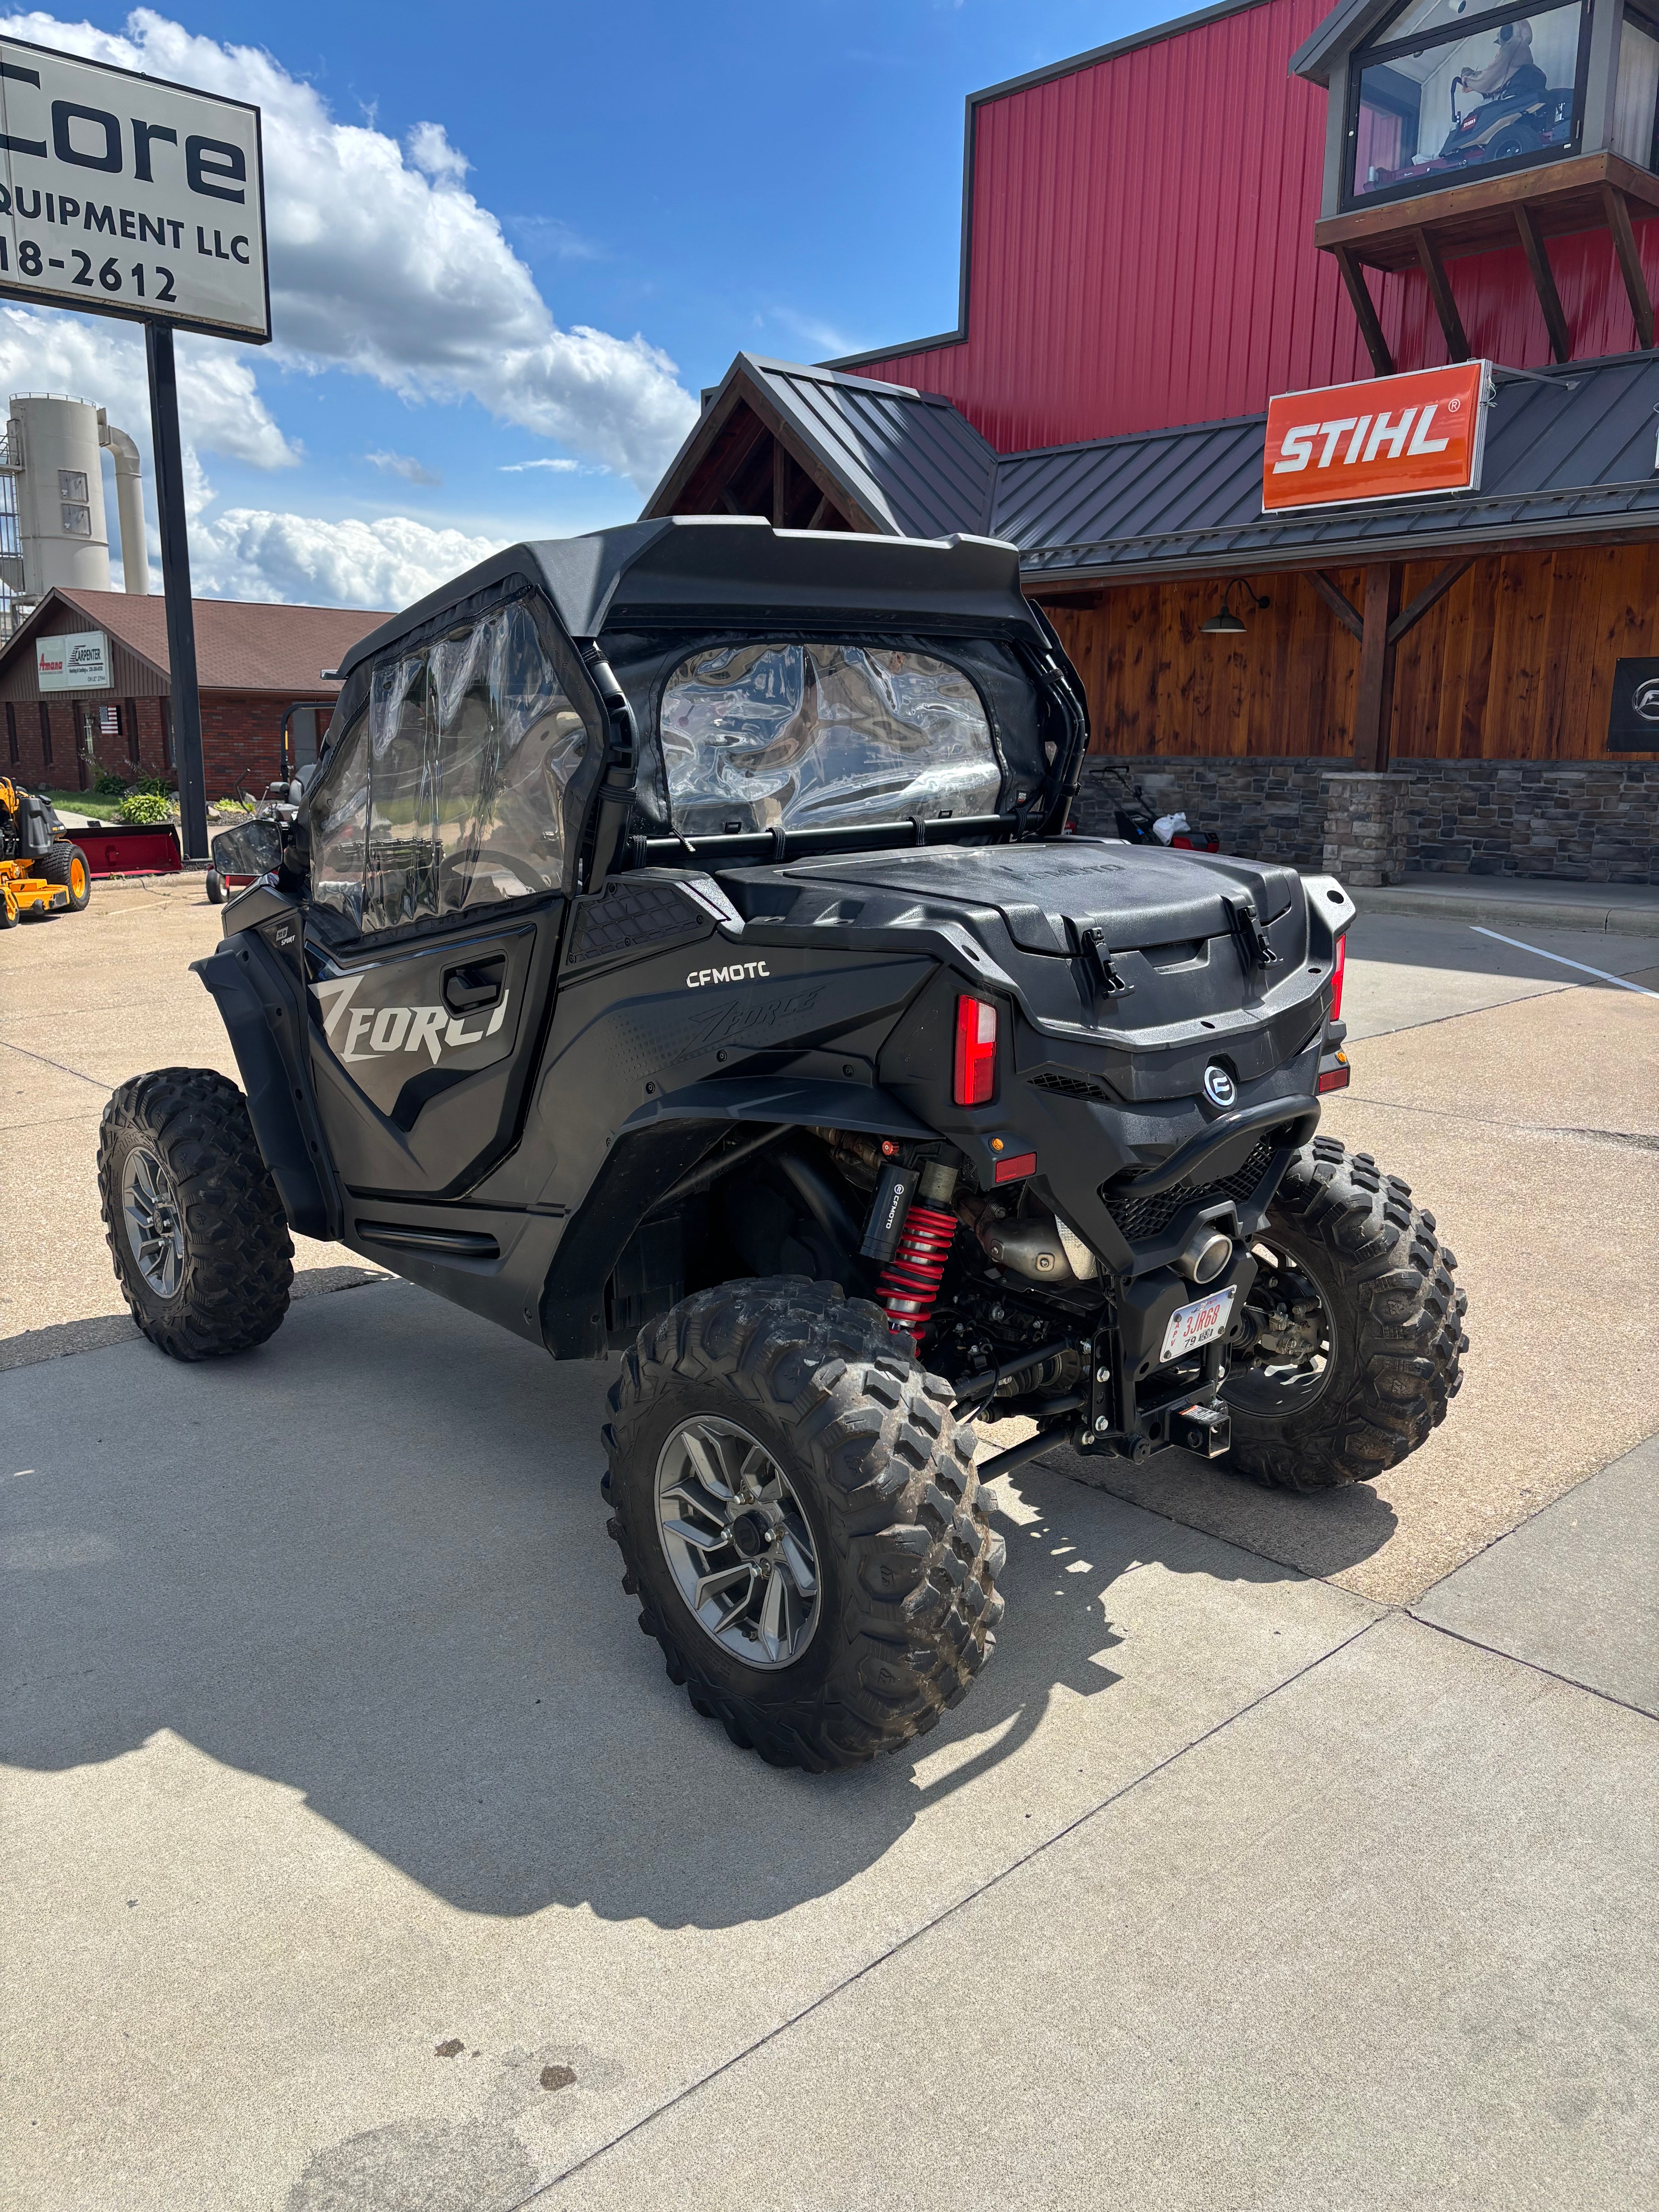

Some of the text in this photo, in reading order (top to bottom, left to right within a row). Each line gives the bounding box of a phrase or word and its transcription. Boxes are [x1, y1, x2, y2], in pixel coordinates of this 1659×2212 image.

[197, 226, 249, 264] LLC
[1273, 404, 1449, 474] STIHL
[39, 653, 63, 671] Amana
[75, 649, 101, 661] CARPENTER
[1011, 864, 1125, 881] CFMOTO
[281, 935, 295, 946] SPORT
[886, 1195, 899, 1229] CFMOTO
[1183, 1304, 1220, 1337] 3JR68
[1185, 1336, 1197, 1348] 79
